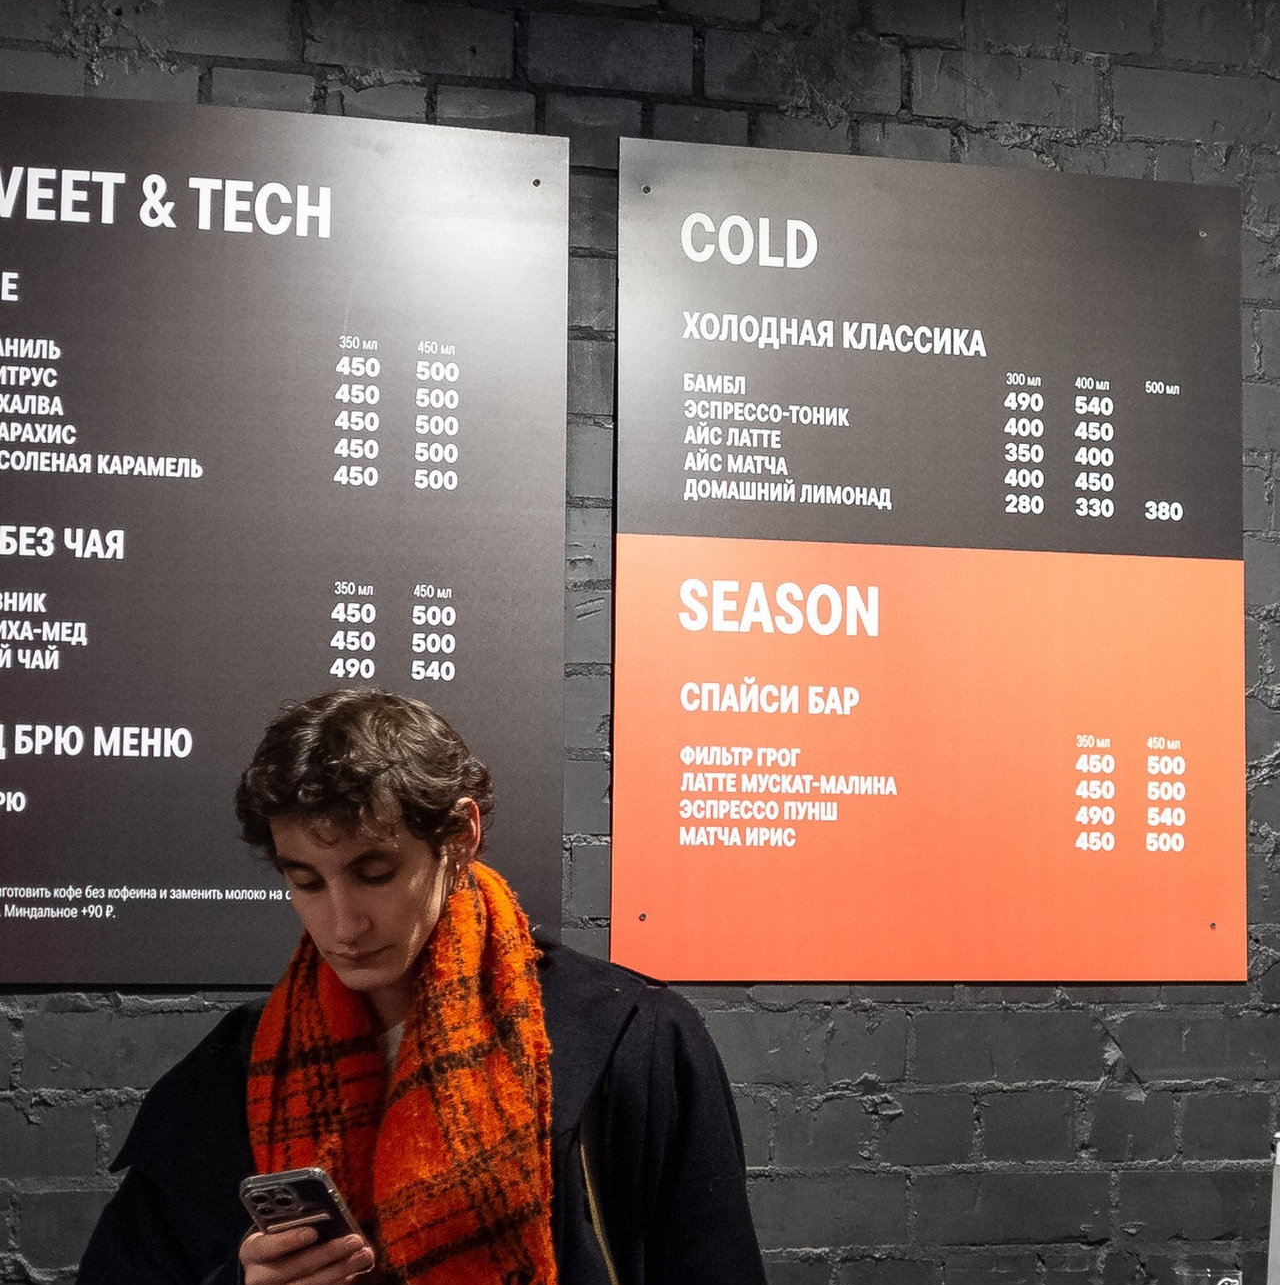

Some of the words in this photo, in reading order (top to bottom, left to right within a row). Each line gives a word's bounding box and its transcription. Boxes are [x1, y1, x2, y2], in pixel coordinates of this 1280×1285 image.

[139, 173, 177, 229] &
[188, 175, 333, 239] TECH
[680, 212, 818, 269] COLD
[338, 335, 360, 350] 350
[362, 339, 378, 351] мл
[681, 311, 835, 350] ХОЛОДНАЯ
[842, 321, 987, 357] КЛАССИКА
[0, 337, 61, 360] НИЛЬ
[417, 340, 439, 355] 450
[440, 344, 456, 356] мл
[335, 356, 381, 378] 450
[415, 360, 460, 383] 500
[683, 372, 746, 395] БАМБЛ
[1005, 372, 1026, 386] 300
[1026, 376, 1042, 387] мл
[1074, 376, 1095, 390] 400
[1095, 380, 1110, 391] мл
[1145, 380, 1165, 395] 500
[1165, 384, 1180, 395] мл
[334, 383, 380, 405] 450
[415, 387, 460, 410] 500
[1003, 391, 1044, 412] 490
[683, 400, 851, 428] ЭСПРЕССО-ТОНИК
[1074, 395, 1114, 416] 540
[334, 410, 380, 432] 450
[415, 414, 459, 436] 500
[1003, 417, 1044, 438] 400
[1074, 421, 1114, 442] 450
[683, 420, 723, 446] АЙС
[725, 427, 782, 449] ЛАТТЕ
[333, 437, 379, 460] 450
[414, 441, 459, 464] 500
[1004, 442, 1044, 464] 350
[1074, 446, 1115, 467] 400
[97, 454, 204, 479] КАРАМЕЛЬ
[683, 447, 723, 473] АЙС
[727, 453, 789, 476] МАТЧА
[333, 465, 379, 487] 450
[414, 469, 458, 491] 500
[1004, 468, 1045, 489] 400
[1074, 471, 1115, 492] 450
[683, 478, 796, 503] ДОМАШНИЙ
[799, 483, 893, 511] ЛИМОНАД
[1004, 493, 1045, 515] 280
[1075, 497, 1115, 518] 330
[1144, 500, 1184, 521] 380
[0, 525, 55, 557] БЕЗ
[63, 527, 125, 560] ЧАЯ
[334, 580, 356, 596] 350
[357, 585, 374, 596] мл
[413, 584, 435, 598] 450
[436, 588, 452, 599] мл
[0, 591, 47, 613] НИК
[330, 602, 377, 624] 450
[678, 578, 879, 637] SEASON
[412, 605, 457, 626] 500
[330, 630, 376, 652] 450
[411, 632, 456, 654] 500
[17, 644, 60, 670] ЧАЙ
[329, 658, 376, 679] 490
[410, 660, 456, 681] 540
[680, 676, 799, 714] СПАЙСИ
[808, 685, 860, 715] БАР
[14, 724, 84, 756] БРЮ
[93, 726, 193, 758] МЕНЮ
[1076, 734, 1096, 748] 350
[1096, 738, 1111, 749] мл
[1146, 736, 1166, 750] 450
[1166, 739, 1181, 750] мл
[679, 745, 754, 767] ФИЛЬТР
[756, 747, 801, 768] ГРОГ
[1075, 754, 1115, 774] 450
[1147, 755, 1186, 776] 500
[680, 772, 737, 793] ЛАТТЕ
[741, 773, 898, 796] МУСКАТ-МАЛИНА
[1075, 779, 1115, 800] 450
[1147, 781, 1186, 801] 500
[679, 798, 780, 821] ЭСПРЕССО
[783, 800, 838, 821] ПУНШ
[1075, 805, 1115, 826] 490
[1147, 806, 1186, 827] 540
[679, 826, 742, 847] МАТЧА
[745, 826, 796, 847] ИРИС
[1074, 831, 1115, 852] 450
[1145, 832, 1185, 852] 500
[0, 886, 52, 899] готовить
[53, 884, 83, 901] кофе
[84, 884, 106, 899] без
[107, 885, 157, 902] кофеина
[159, 888, 168, 900] и
[169, 888, 224, 900] заменить
[225, 889, 267, 901] молоко
[268, 889, 283, 901] на
[4, 903, 79, 920] Миндальное
[81, 904, 103, 919] +90
